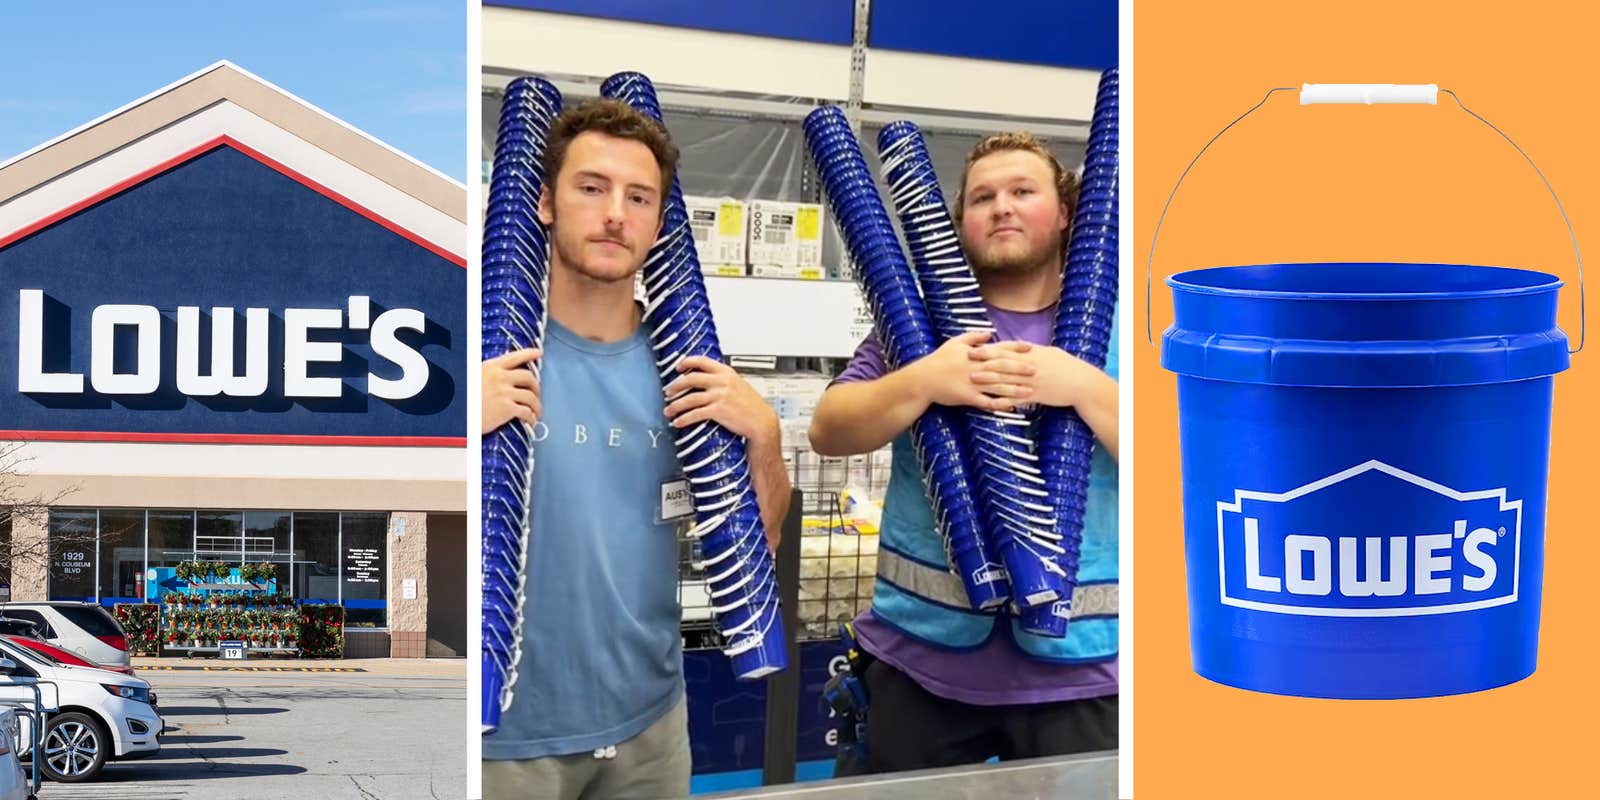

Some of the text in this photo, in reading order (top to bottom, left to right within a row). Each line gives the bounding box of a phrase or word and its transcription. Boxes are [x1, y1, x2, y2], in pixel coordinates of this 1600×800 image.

[18, 289, 430, 400] LOWE'S
[532, 421, 662, 449] OBEY
[63, 552, 84, 560] 1929
